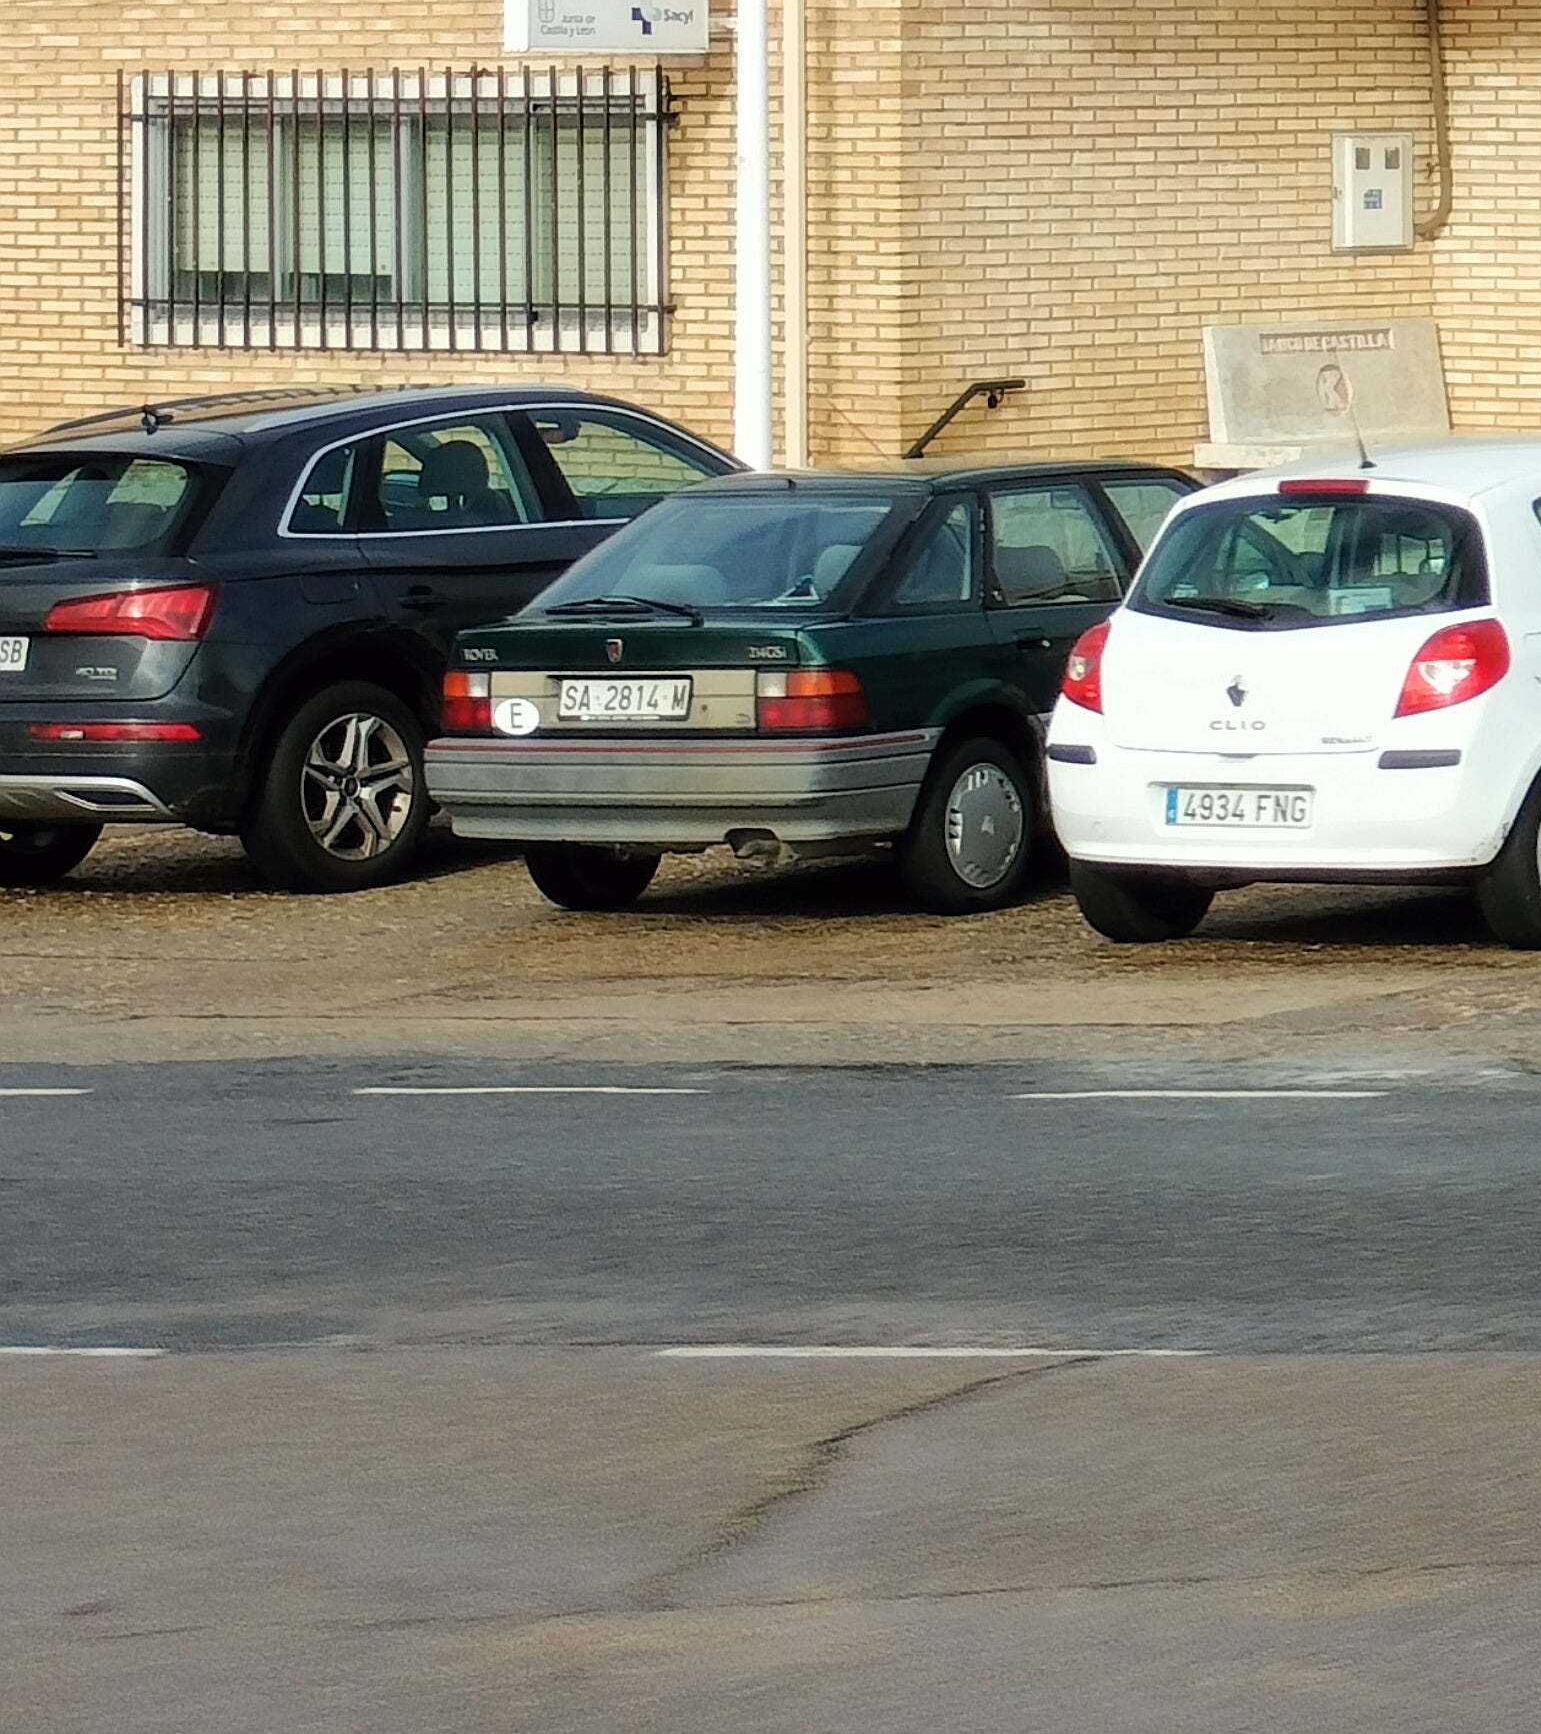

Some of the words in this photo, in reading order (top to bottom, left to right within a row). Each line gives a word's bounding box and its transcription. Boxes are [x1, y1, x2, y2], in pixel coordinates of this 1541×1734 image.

[663, 9, 694, 24] Sacyl
[1321, 333, 1388, 350] CASTILLA
[463, 648, 499, 661] ROVER
[564, 685, 592, 711] SA
[604, 685, 659, 711] 2814
[671, 684, 687, 711] M
[509, 702, 524, 729] E
[1209, 720, 1266, 731] CLIO
[1183, 793, 1245, 821] 4934
[1255, 794, 1307, 823] FNG
